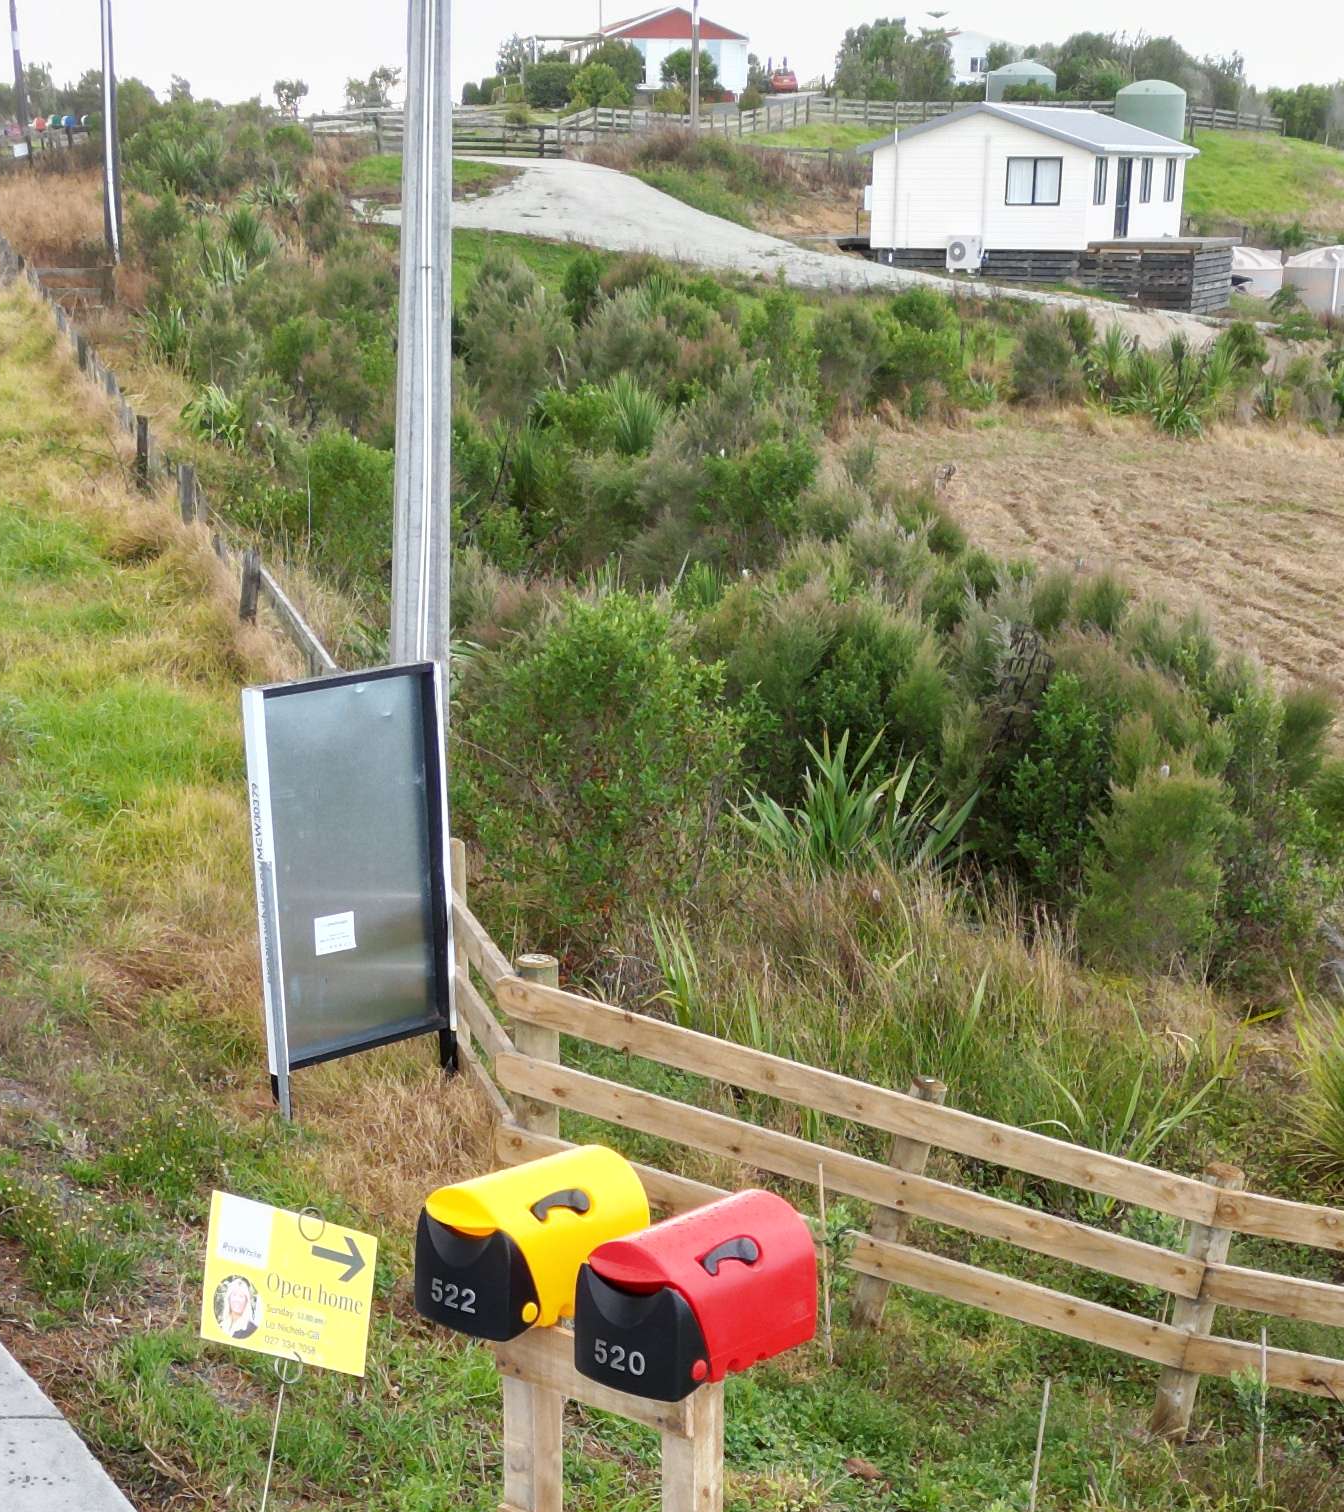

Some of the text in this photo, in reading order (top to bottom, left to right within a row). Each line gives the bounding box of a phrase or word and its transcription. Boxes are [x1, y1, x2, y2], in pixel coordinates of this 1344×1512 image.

[266, 1272, 364, 1315] Open home
[266, 1303, 294, 1319] Sunday
[431, 1278, 477, 1315] 522
[264, 1335, 279, 1345] 027
[594, 1338, 646, 1377] 520
